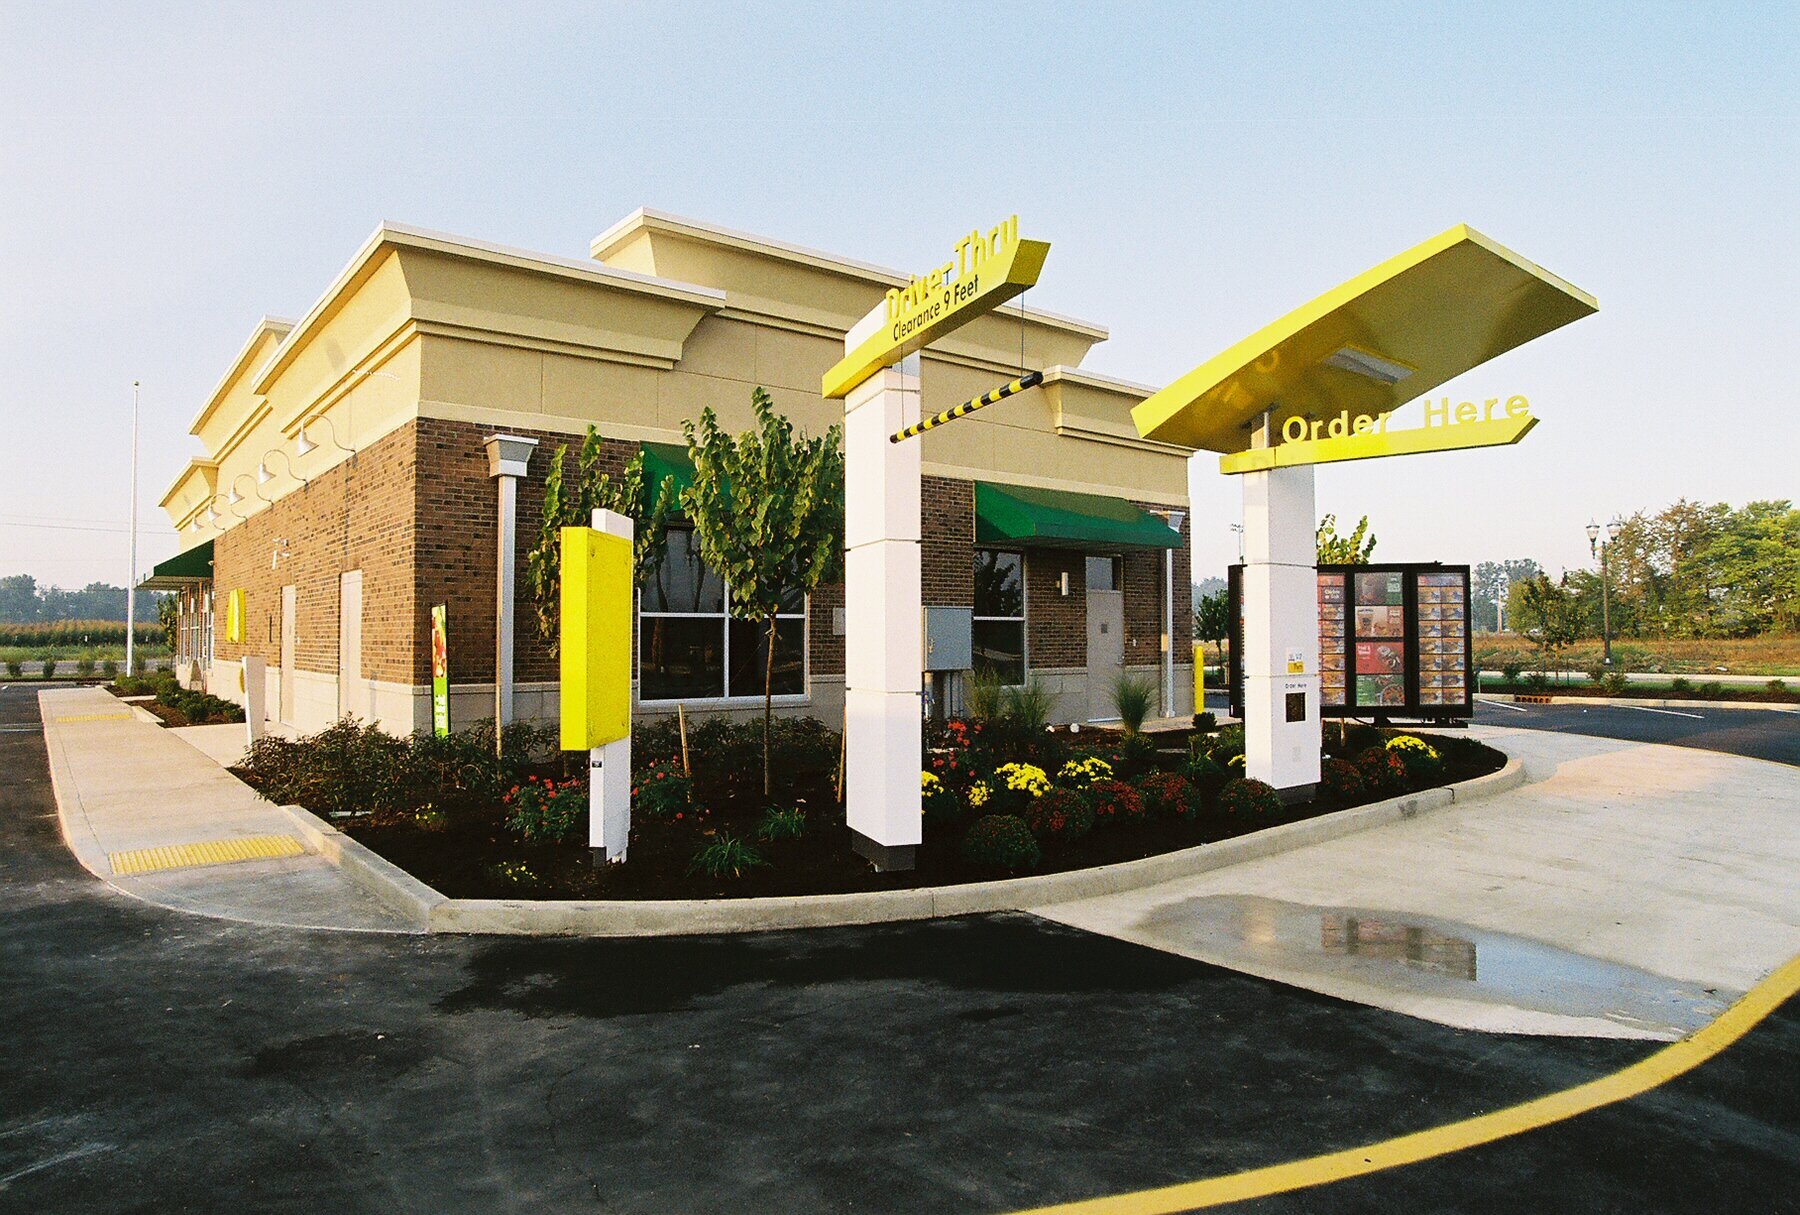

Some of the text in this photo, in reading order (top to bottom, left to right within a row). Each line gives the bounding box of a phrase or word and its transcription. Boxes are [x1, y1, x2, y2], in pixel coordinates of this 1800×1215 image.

[893, 274, 979, 341] Clearance 9 Feet
[1282, 394, 1531, 444] Order Here
